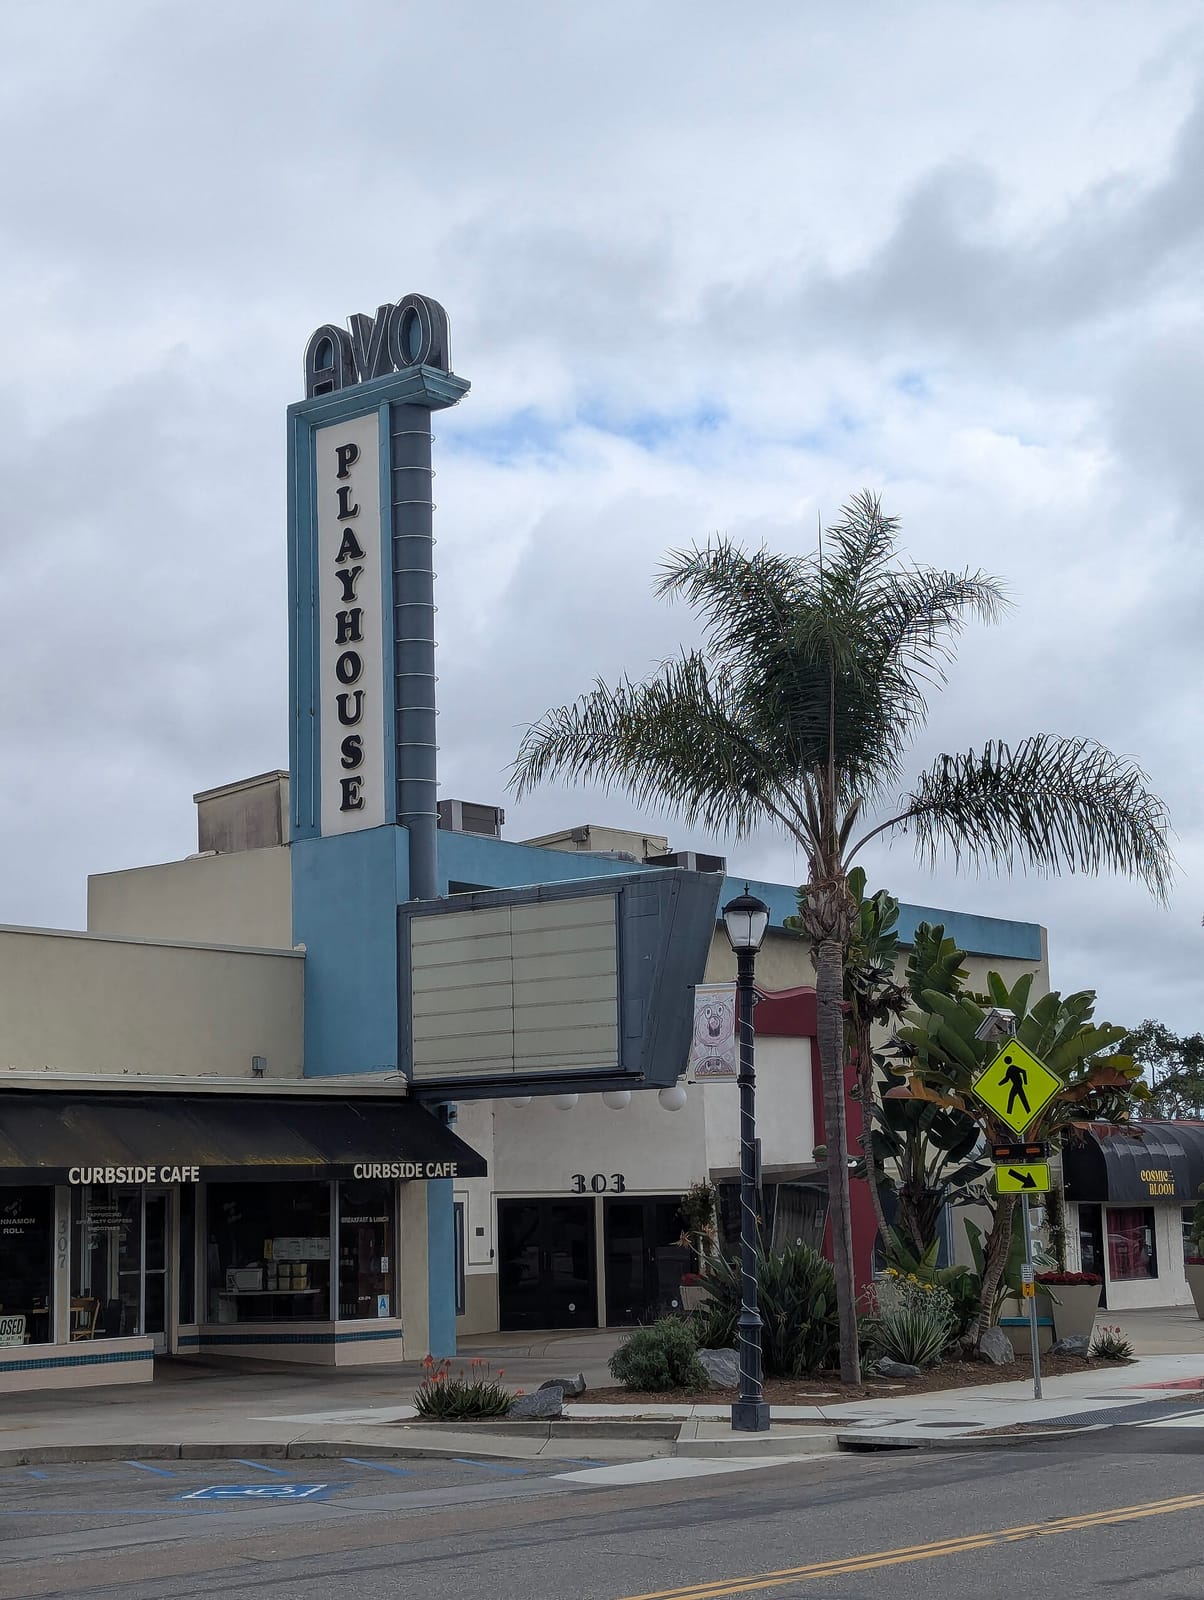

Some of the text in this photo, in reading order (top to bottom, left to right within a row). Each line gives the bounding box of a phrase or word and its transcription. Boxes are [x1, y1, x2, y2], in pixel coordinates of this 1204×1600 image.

[303, 293, 451, 400] AVO
[334, 442, 366, 812] PLAYHOUSE
[68, 1165, 200, 1186] CURBSIDE CAFE
[353, 1161, 458, 1180] CURBSIDE CAFE
[1140, 1169, 1172, 1182] COSMIC
[571, 1173, 627, 1194] 303
[1149, 1183, 1175, 1196] BLOOM
[58, 1220, 68, 1269] 307
[379, 1297, 386, 1309] A
